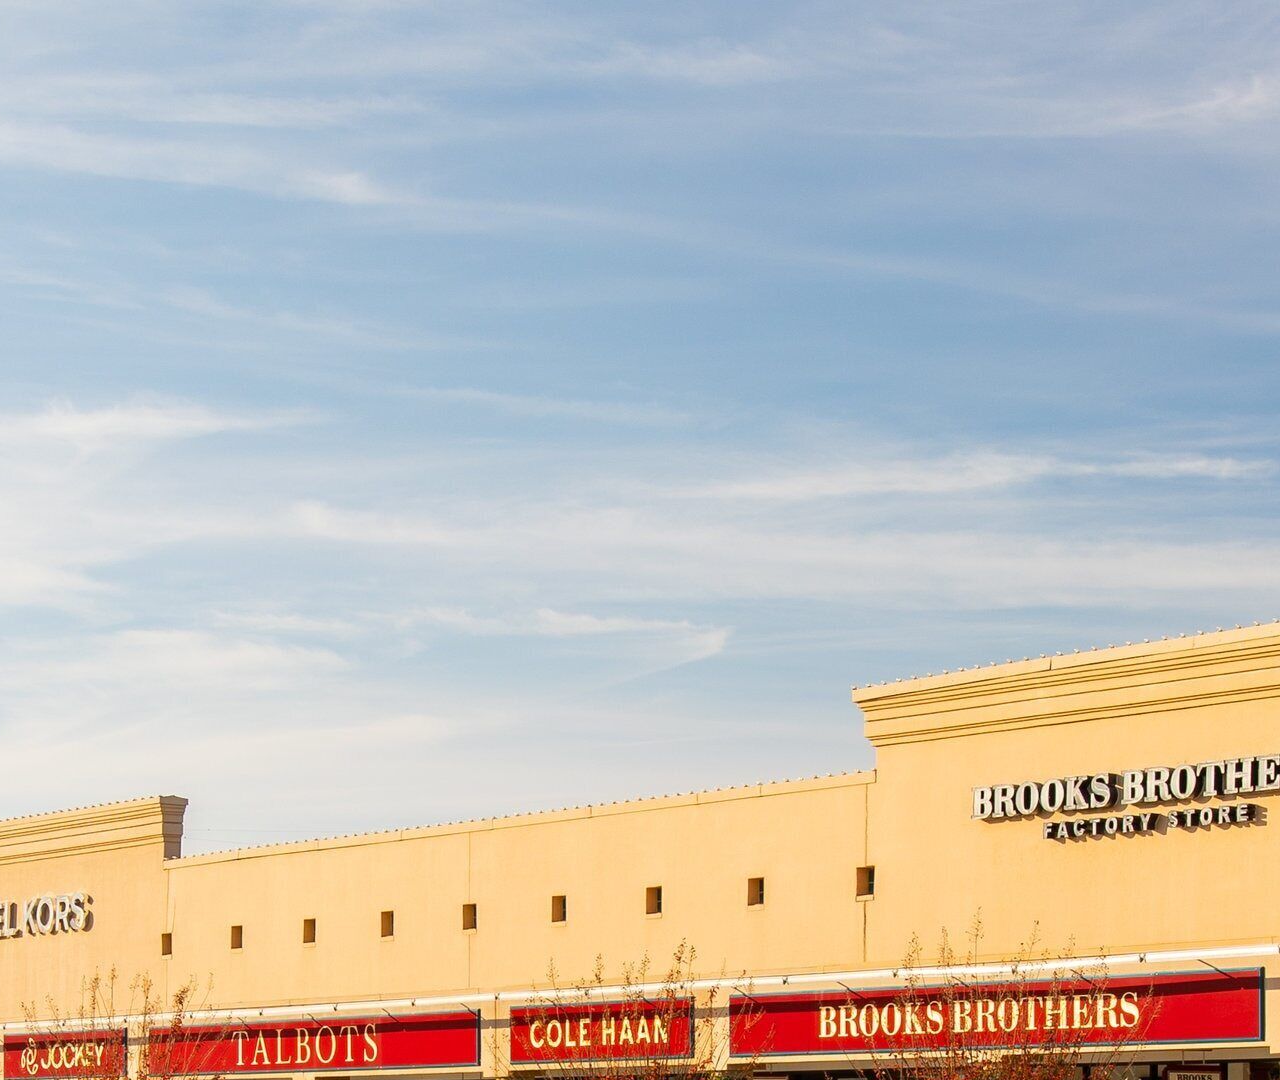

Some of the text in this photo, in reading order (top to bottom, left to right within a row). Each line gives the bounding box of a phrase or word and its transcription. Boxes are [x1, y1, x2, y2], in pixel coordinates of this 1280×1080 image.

[972, 772, 1112, 820] BROOKS
[1043, 804, 1248, 840] FACTORY STORE
[23, 891, 85, 934] KORS
[529, 1014, 668, 1048] COLE HAAN
[819, 992, 1140, 1038] BROOKS BROTHERS
[40, 1042, 104, 1069] JOCKEY
[231, 1023, 378, 1066] TALBOTS
